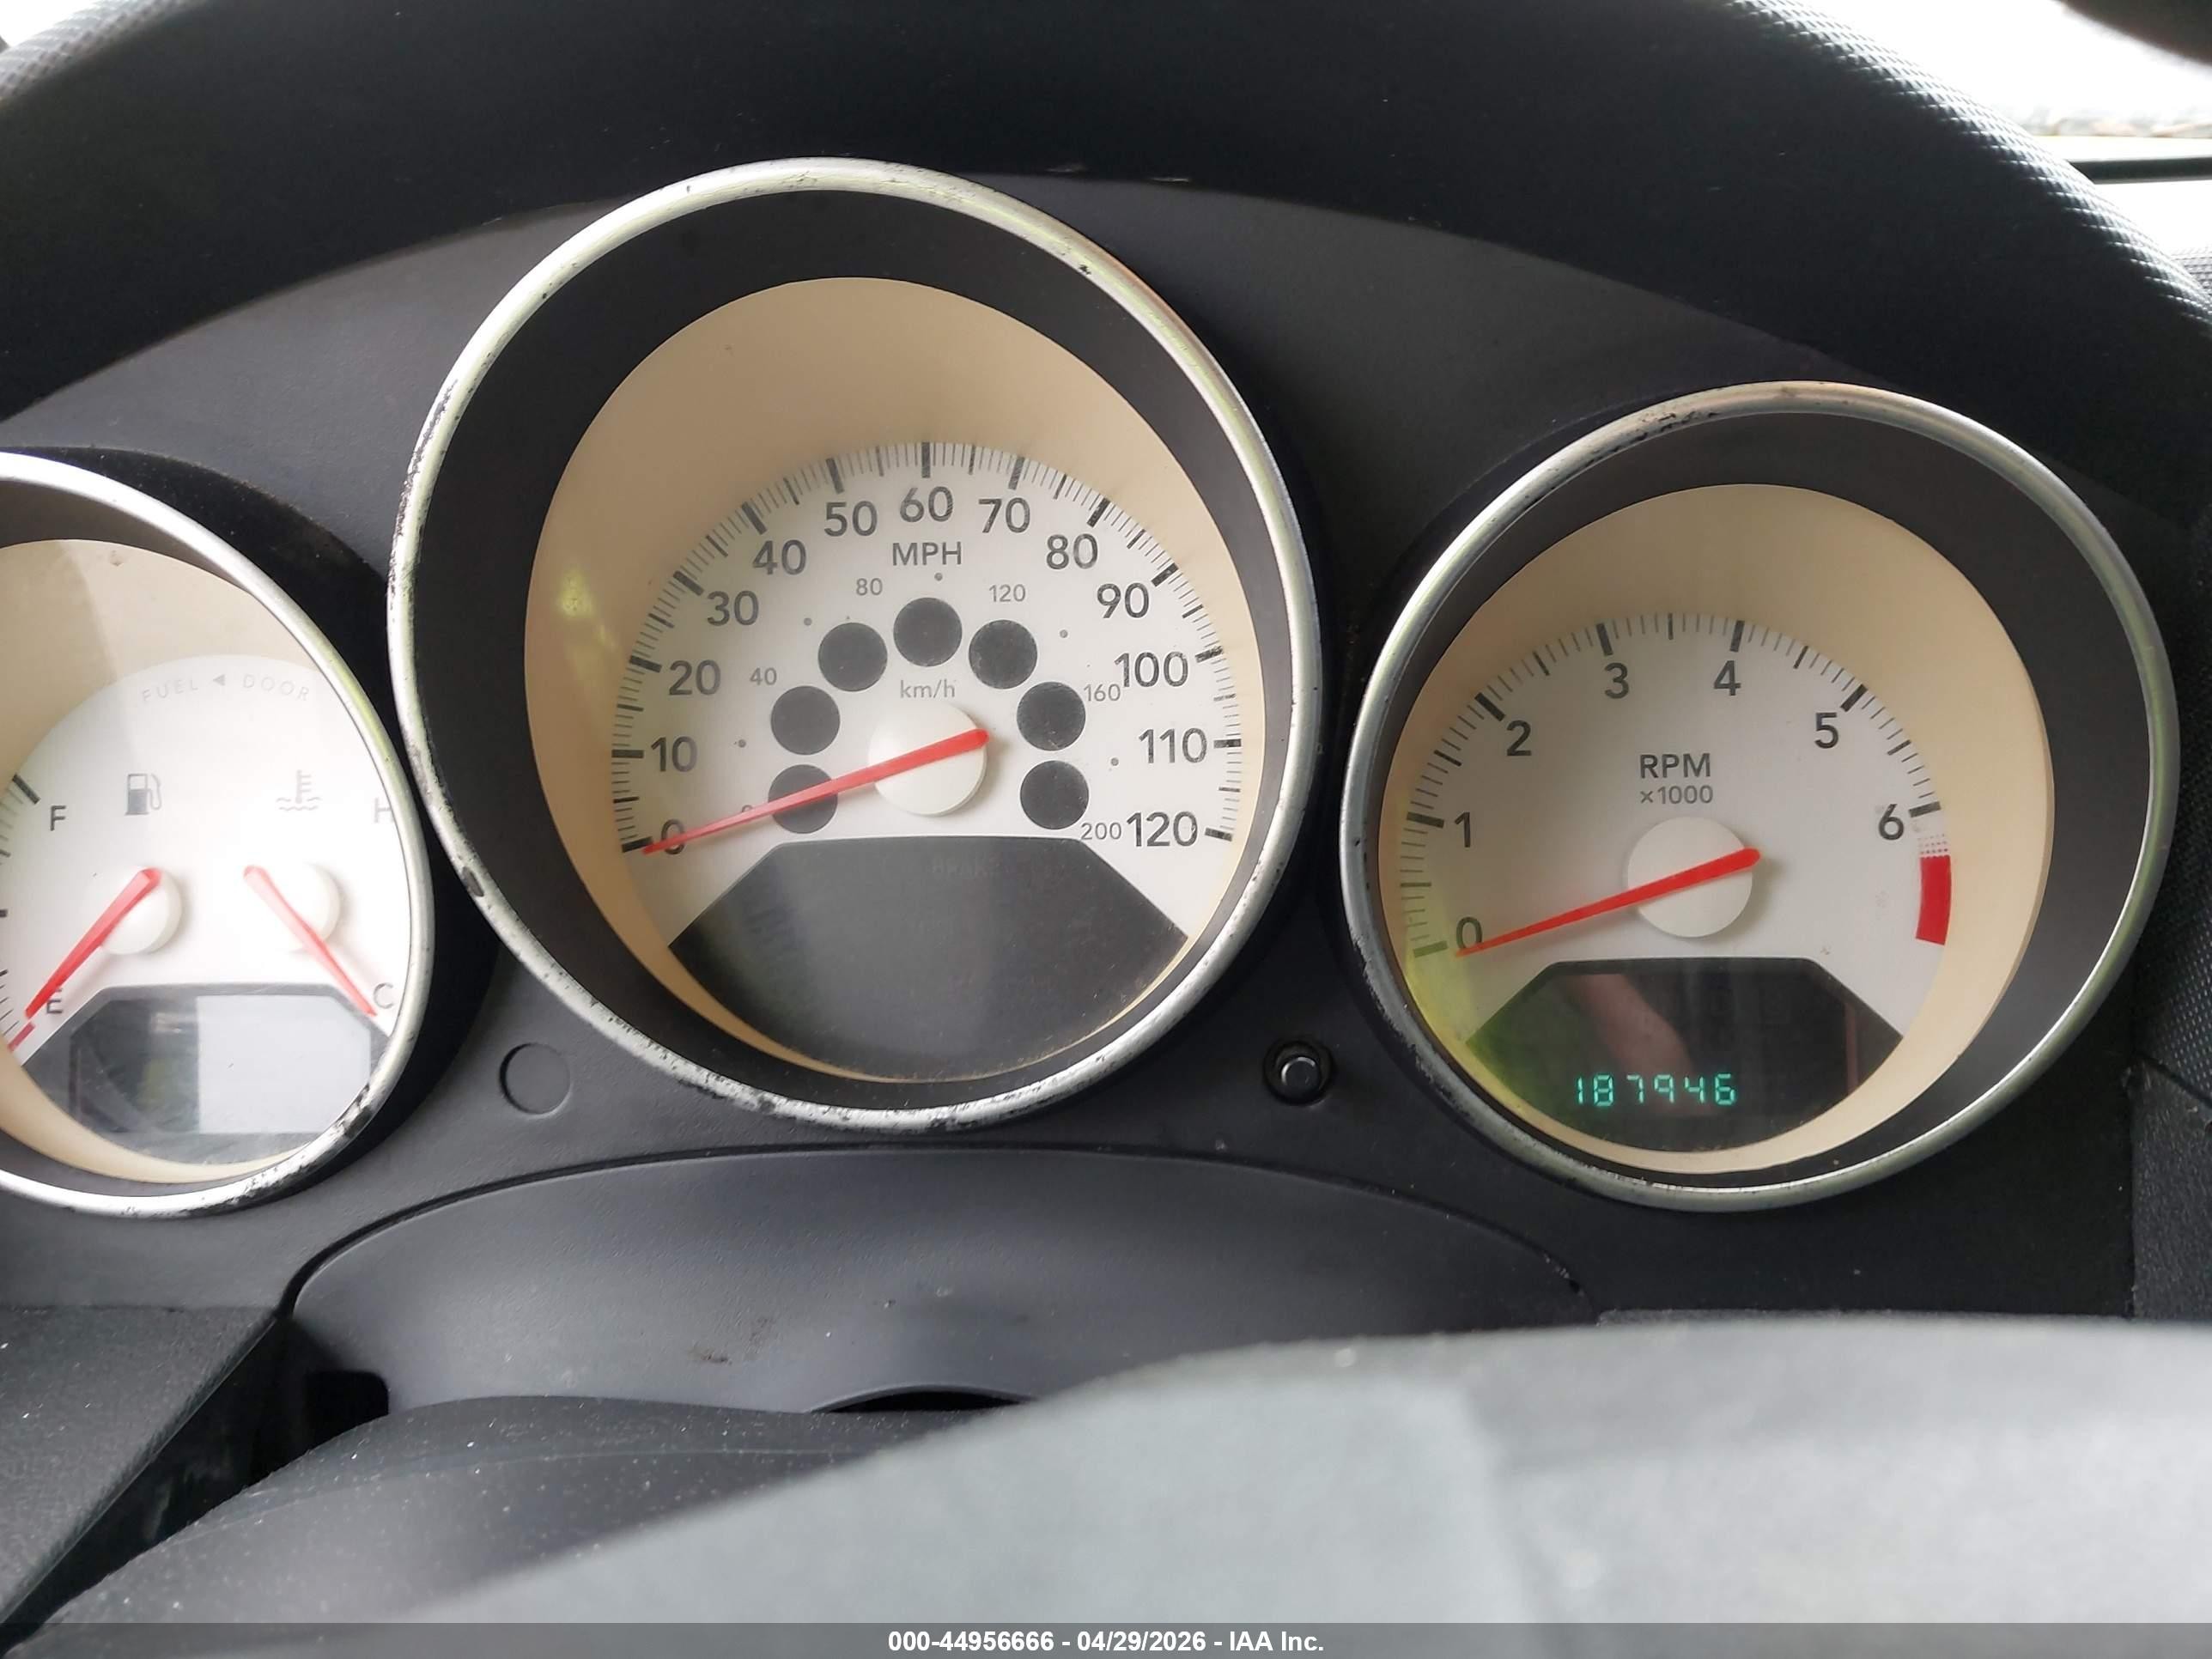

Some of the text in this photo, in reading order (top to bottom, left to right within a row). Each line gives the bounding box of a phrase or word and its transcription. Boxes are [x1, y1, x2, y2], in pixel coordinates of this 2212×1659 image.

[823, 501, 878, 537] 50
[898, 486, 954, 523] 60
[978, 497, 1030, 533] 70
[753, 539, 806, 576] 40
[891, 542, 963, 566] MPH
[1046, 533, 1097, 570] 80
[855, 577, 883, 597] 80
[988, 583, 1026, 603] 120
[1097, 583, 1150, 619] 90
[707, 591, 759, 627] 30
[143, 674, 309, 702] FUEL DOOR
[669, 659, 720, 696] 20
[749, 667, 777, 685] 40
[1115, 652, 1188, 688] 100
[1604, 662, 1629, 699] 3
[1714, 660, 1741, 696] 4
[900, 678, 956, 701] km/h
[1084, 684, 1121, 702] 160
[1139, 728, 1207, 763] 110
[1505, 720, 1532, 757] 2
[1814, 712, 1838, 749] 5
[651, 736, 697, 772] 10
[1639, 753, 1711, 778] RPM
[51, 805, 66, 831] F
[1080, 822, 1121, 841] 200
[1126, 811, 1198, 847] 120
[1454, 811, 1472, 848] 1
[1877, 803, 1905, 841] 6
[660, 819, 687, 854] 0
[1455, 915, 1484, 953] 0
[374, 982, 394, 1009] C
[1575, 1073, 1737, 1107] 187946
